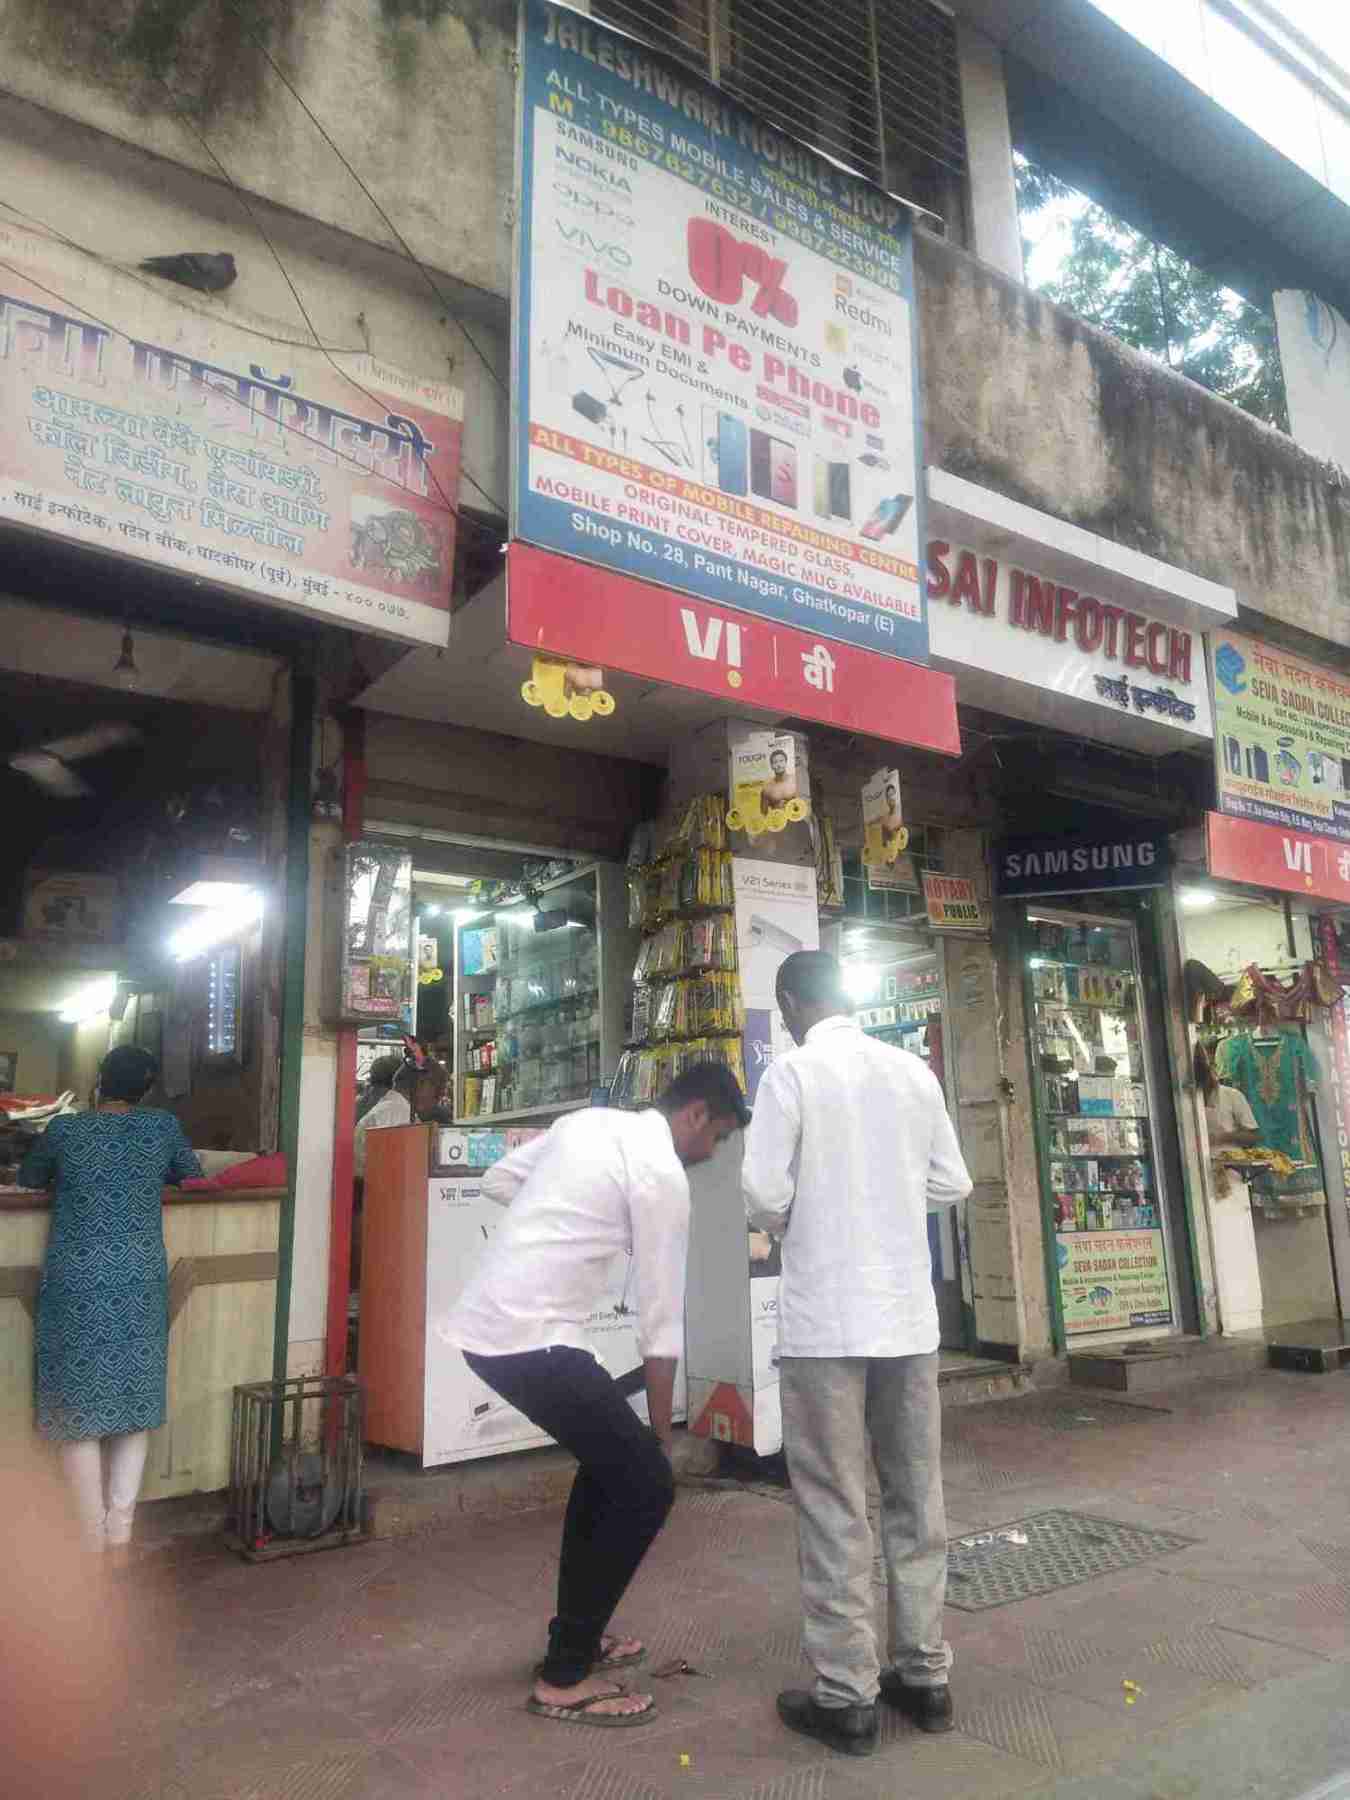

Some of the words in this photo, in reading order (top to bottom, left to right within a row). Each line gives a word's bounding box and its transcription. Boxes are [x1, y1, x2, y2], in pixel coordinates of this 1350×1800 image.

[546, 69, 591, 105] ALL
[598, 93, 665, 144] TYPES
[671, 132, 746, 185] MOBILE
[751, 176, 809, 222] SALES
[814, 213, 829, 232] &
[831, 223, 903, 273] SERVICE
[555, 144, 632, 193] NOKIA
[557, 119, 638, 172] SAMSUNG
[705, 200, 778, 248] INTEREST
[687, 216, 799, 329] 0%
[835, 294, 892, 337] Redmi
[567, 319, 650, 369] Minimum
[655, 358, 749, 410] Documents
[585, 266, 691, 345] Loan
[703, 324, 752, 372] Pe
[763, 351, 881, 429] Phone
[613, 321, 656, 353] Easy
[661, 343, 692, 368] EMI
[697, 360, 710, 376] &
[657, 279, 720, 319] DOWN
[726, 311, 822, 368] PAYMENTS
[535, 428, 575, 456] ALL
[583, 447, 642, 481] TYPES
[647, 471, 679, 492] OF
[683, 485, 753, 520] MOBILE
[754, 506, 850, 555] REPAIRING
[624, 483, 714, 527] ORIGINAL
[718, 517, 799, 558] TEMPERED
[803, 549, 855, 580] GLASS,
[536, 476, 611, 512] MOBILE
[743, 548, 795, 577] MAGIC
[801, 567, 838, 591] MUG
[843, 583, 919, 618] AVAILABLE
[571, 512, 622, 547] Shop
[628, 532, 657, 554] No.
[664, 543, 688, 566] 28,
[694, 552, 733, 582] Pant
[737, 568, 789, 600] Nagar,
[792, 587, 871, 626] Ghatkopar
[874, 612, 895, 637] (E)
[927, 540, 998, 618] SAI
[1009, 567, 1192, 684] INFOTECH
[1251, 677, 1279, 704] SEVA
[1281, 688, 1315, 714] SADAN
[1006, 842, 1157, 878] SAMSUNG
[943, 903, 979, 920] PUBLIC
